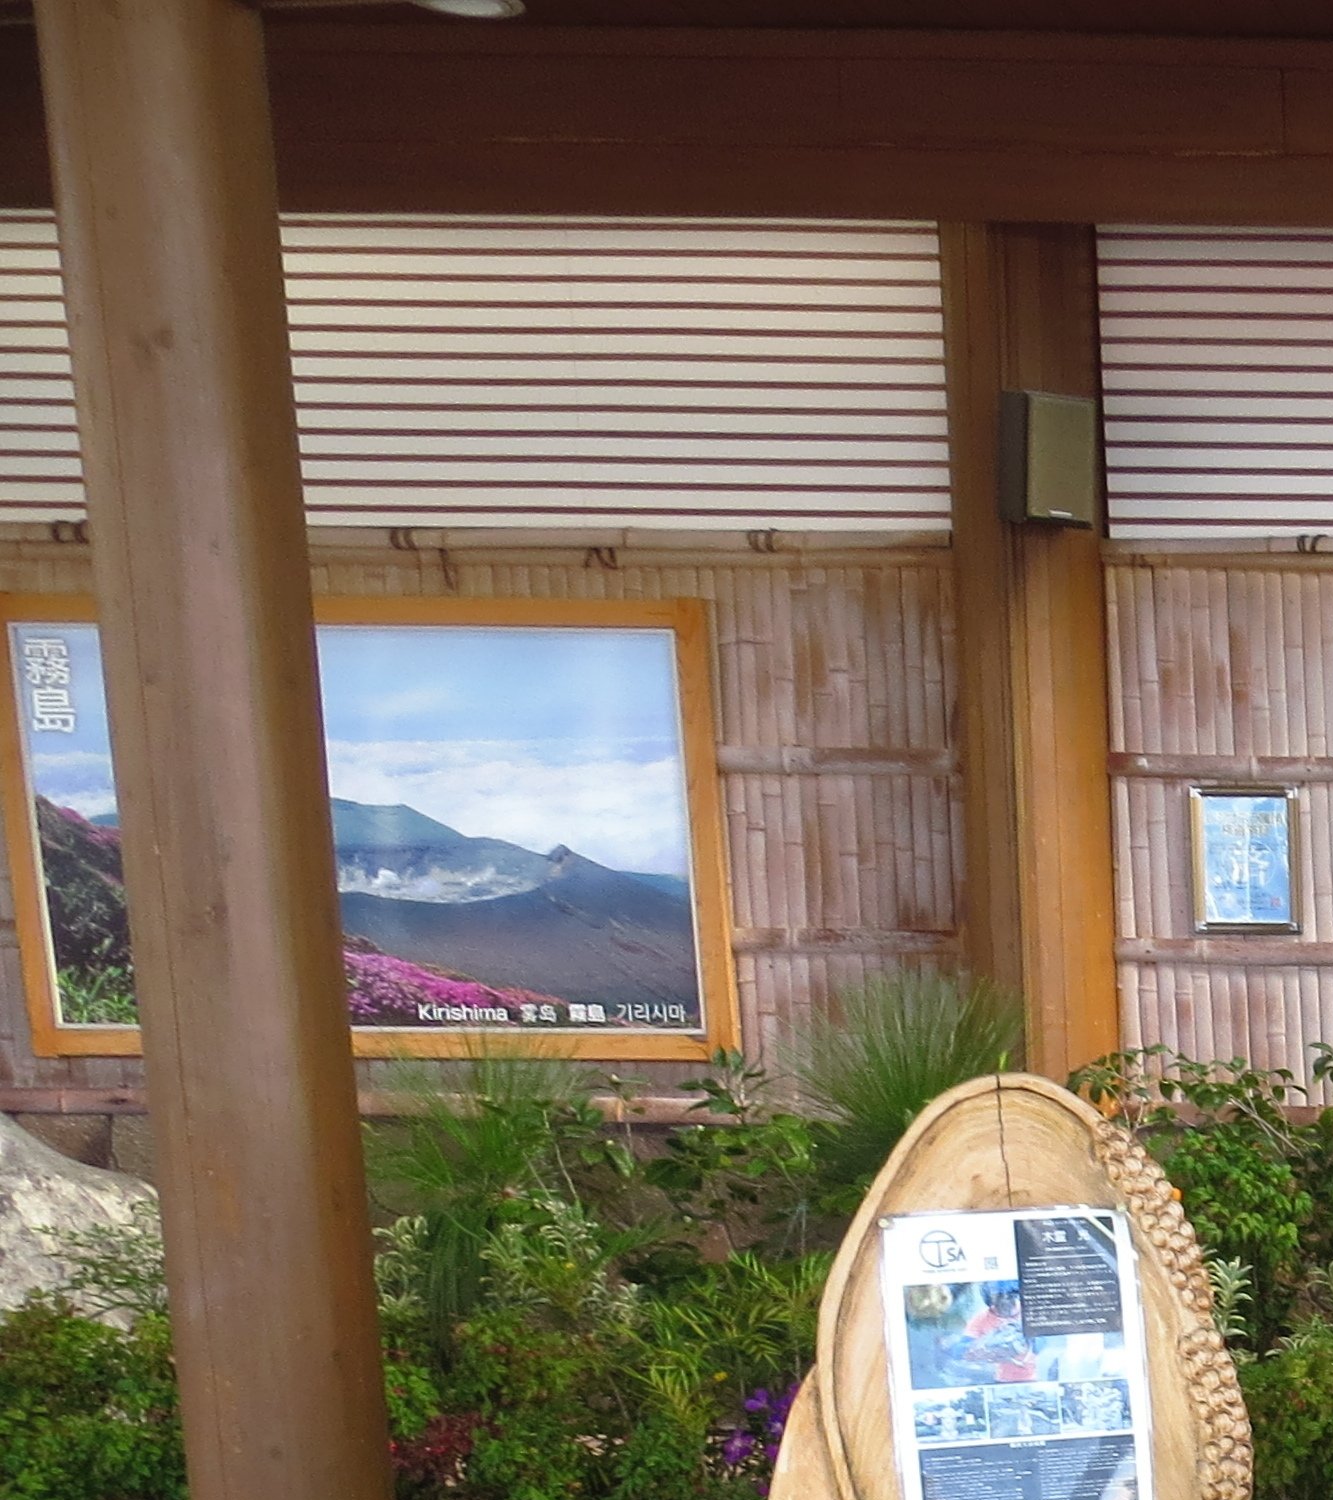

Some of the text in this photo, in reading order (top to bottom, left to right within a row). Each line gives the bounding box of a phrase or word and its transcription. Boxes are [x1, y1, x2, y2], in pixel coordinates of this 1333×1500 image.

[23, 638, 76, 733] 霧島
[417, 1003, 509, 1022] Kirishima
[615, 1003, 687, 1024] 기리시마
